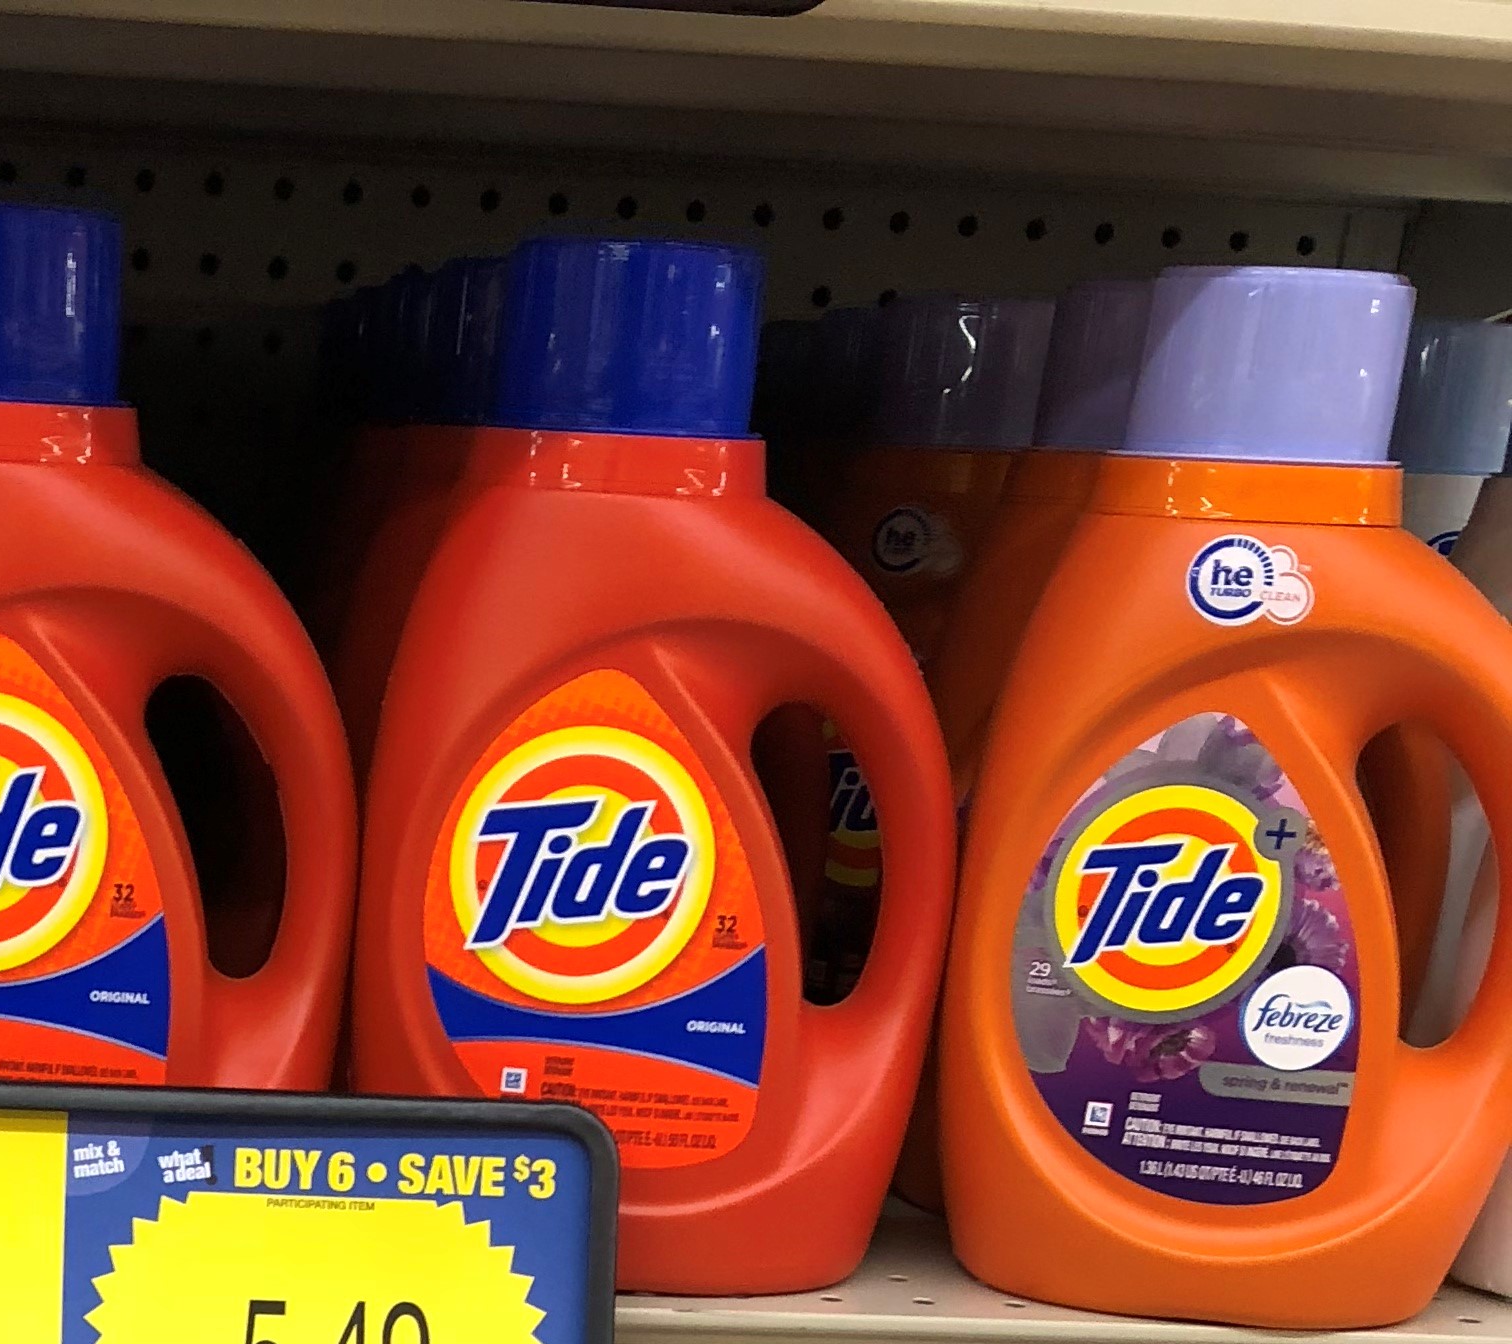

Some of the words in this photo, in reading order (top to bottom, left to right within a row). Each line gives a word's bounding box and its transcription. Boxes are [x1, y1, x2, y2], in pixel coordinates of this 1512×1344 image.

[1210, 559, 1254, 587] he
[1259, 590, 1301, 604] CLEAN
[464, 794, 694, 950] Tide
[113, 883, 135, 902] 32
[1063, 842, 1266, 968] Tide
[715, 915, 738, 934] 32
[1029, 961, 1051, 977] 29
[90, 990, 150, 1005] ORIGINAL
[1252, 993, 1345, 1033] febreze
[686, 1020, 746, 1034] ORIGINAL
[73, 1143, 104, 1161] mix
[106, 1140, 121, 1157] &
[157, 1149, 202, 1169] what
[73, 1157, 125, 1179] match
[163, 1169, 175, 1184] a
[233, 1146, 322, 1190] BUY
[327, 1150, 356, 1192] 6
[397, 1153, 505, 1197] SAVE
[266, 1197, 347, 1210] PARTICIPATING
[349, 1200, 376, 1211] ITEM
